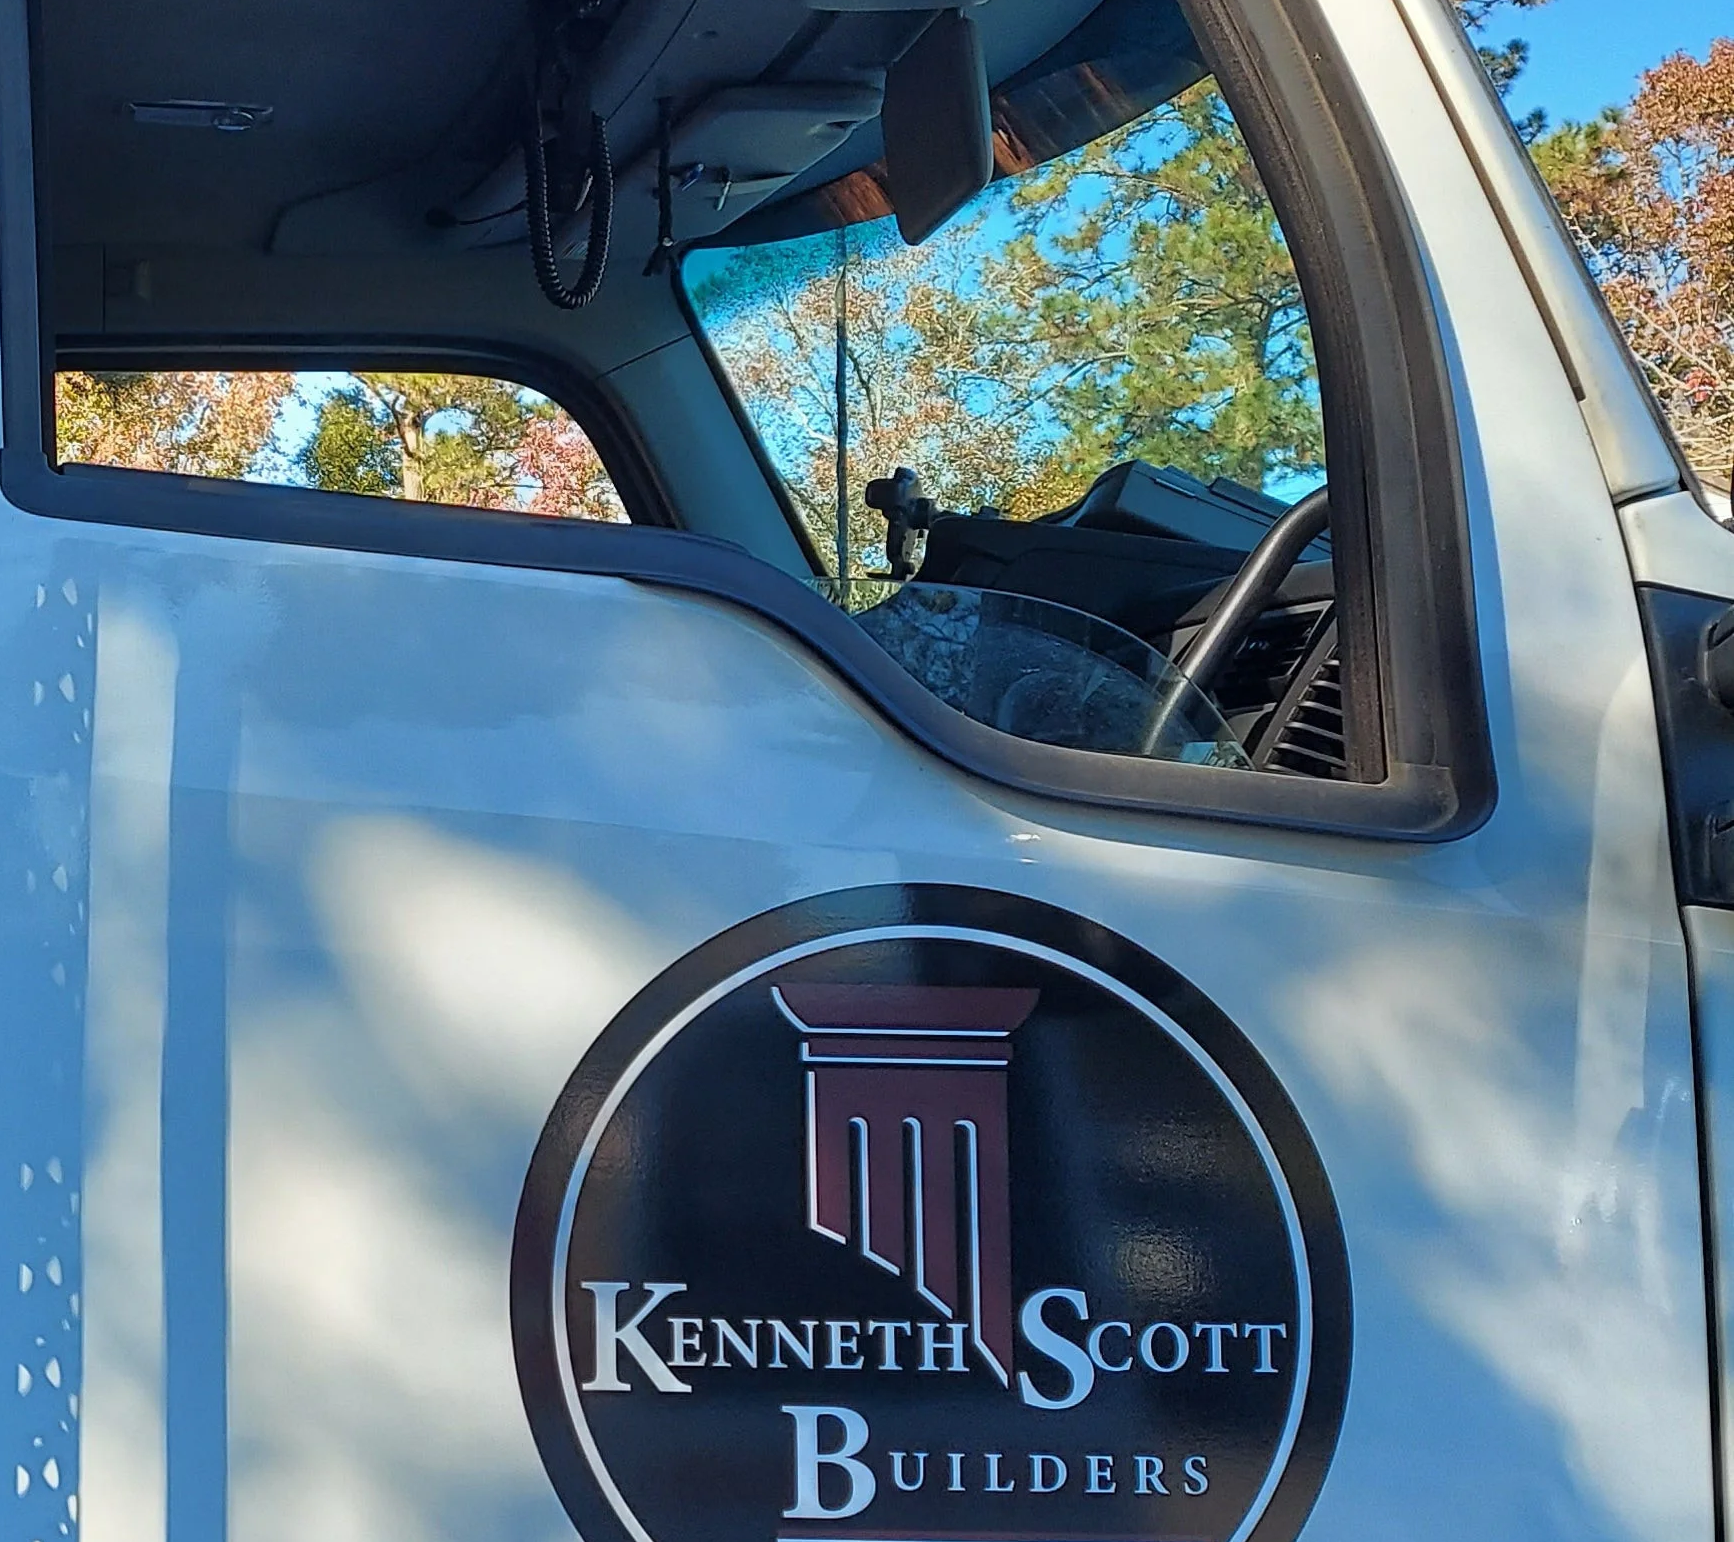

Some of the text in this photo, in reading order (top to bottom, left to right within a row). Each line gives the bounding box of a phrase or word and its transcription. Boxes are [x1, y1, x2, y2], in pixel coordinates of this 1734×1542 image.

[580, 1280, 1288, 1410] KENNETH SCOTT
[781, 1404, 1212, 1521] BUILDERS
